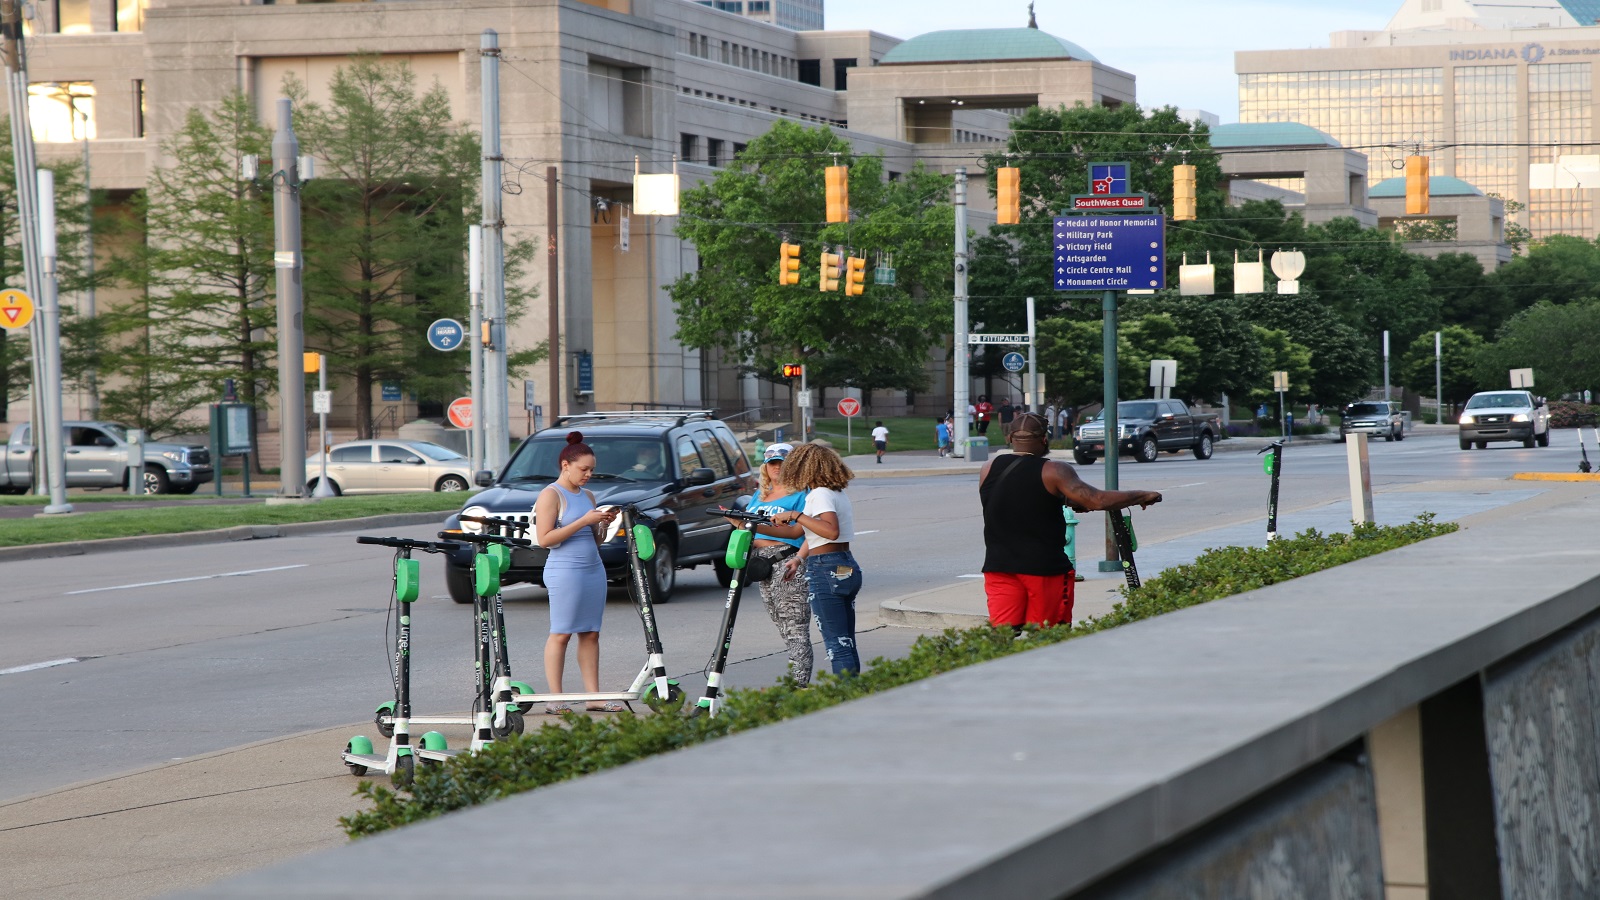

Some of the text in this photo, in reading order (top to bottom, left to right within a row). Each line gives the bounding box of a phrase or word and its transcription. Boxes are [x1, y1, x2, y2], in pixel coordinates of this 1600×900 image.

[1449, 48, 1518, 61] INDIANA
[1075, 199, 1120, 207] SouthWest
[1090, 219, 1097, 227] of
[1099, 219, 1121, 227] Honor
[1066, 231, 1113, 240] Military Park
[1066, 243, 1092, 252] Victory
[1066, 254, 1107, 264] Artsgarden
[1066, 266, 1088, 274] Circle
[1090, 266, 1114, 274] Centre
[1066, 278, 1105, 286] Monument
[725, 589, 736, 609] Lime
[481, 622, 489, 643] Lime
